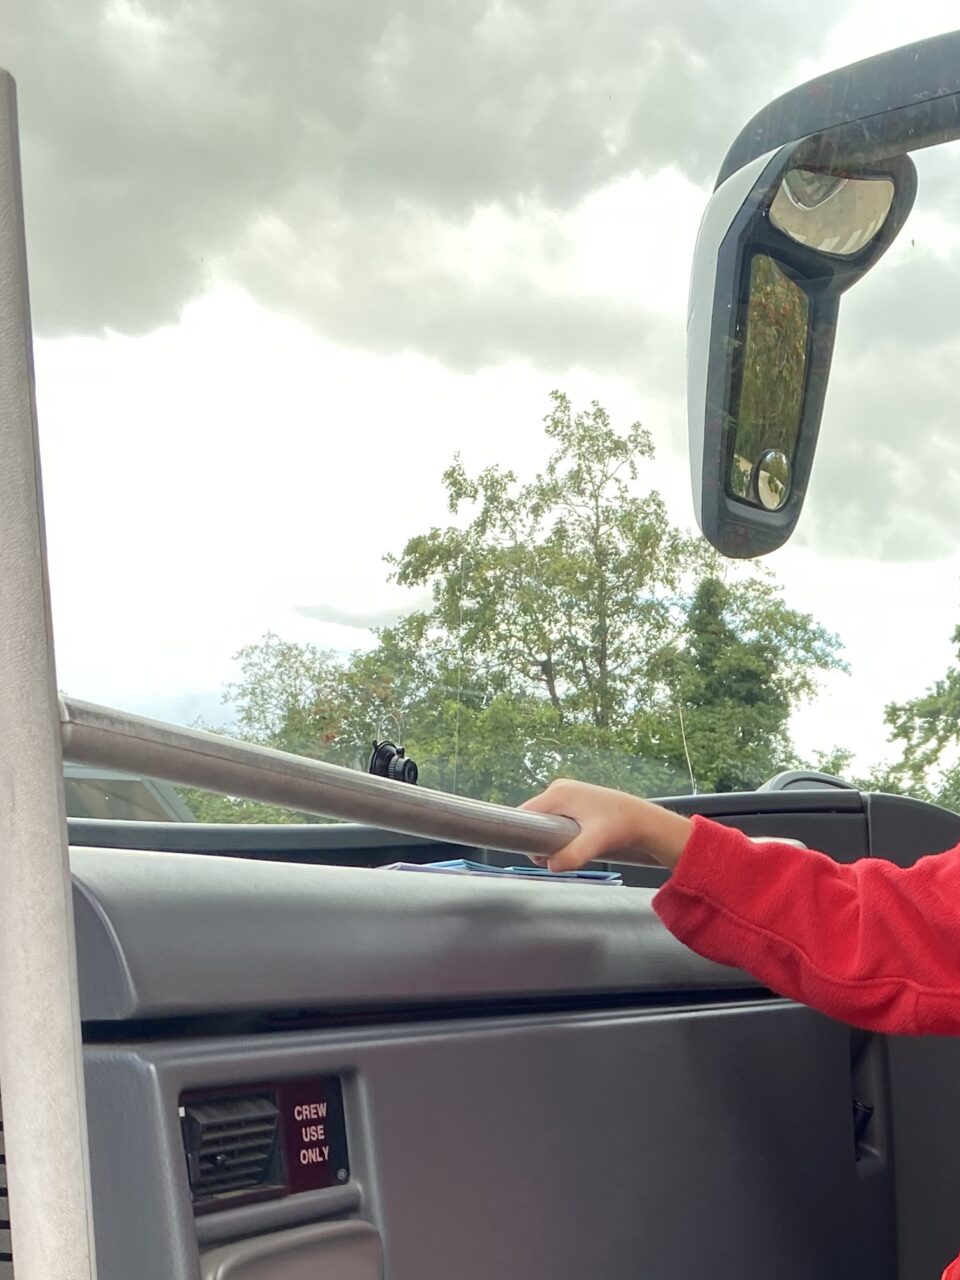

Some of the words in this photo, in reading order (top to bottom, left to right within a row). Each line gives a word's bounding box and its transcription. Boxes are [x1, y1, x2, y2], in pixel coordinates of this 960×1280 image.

[294, 1102, 327, 1121] CREW
[302, 1124, 325, 1142] USE
[300, 1145, 329, 1165] ONLY
